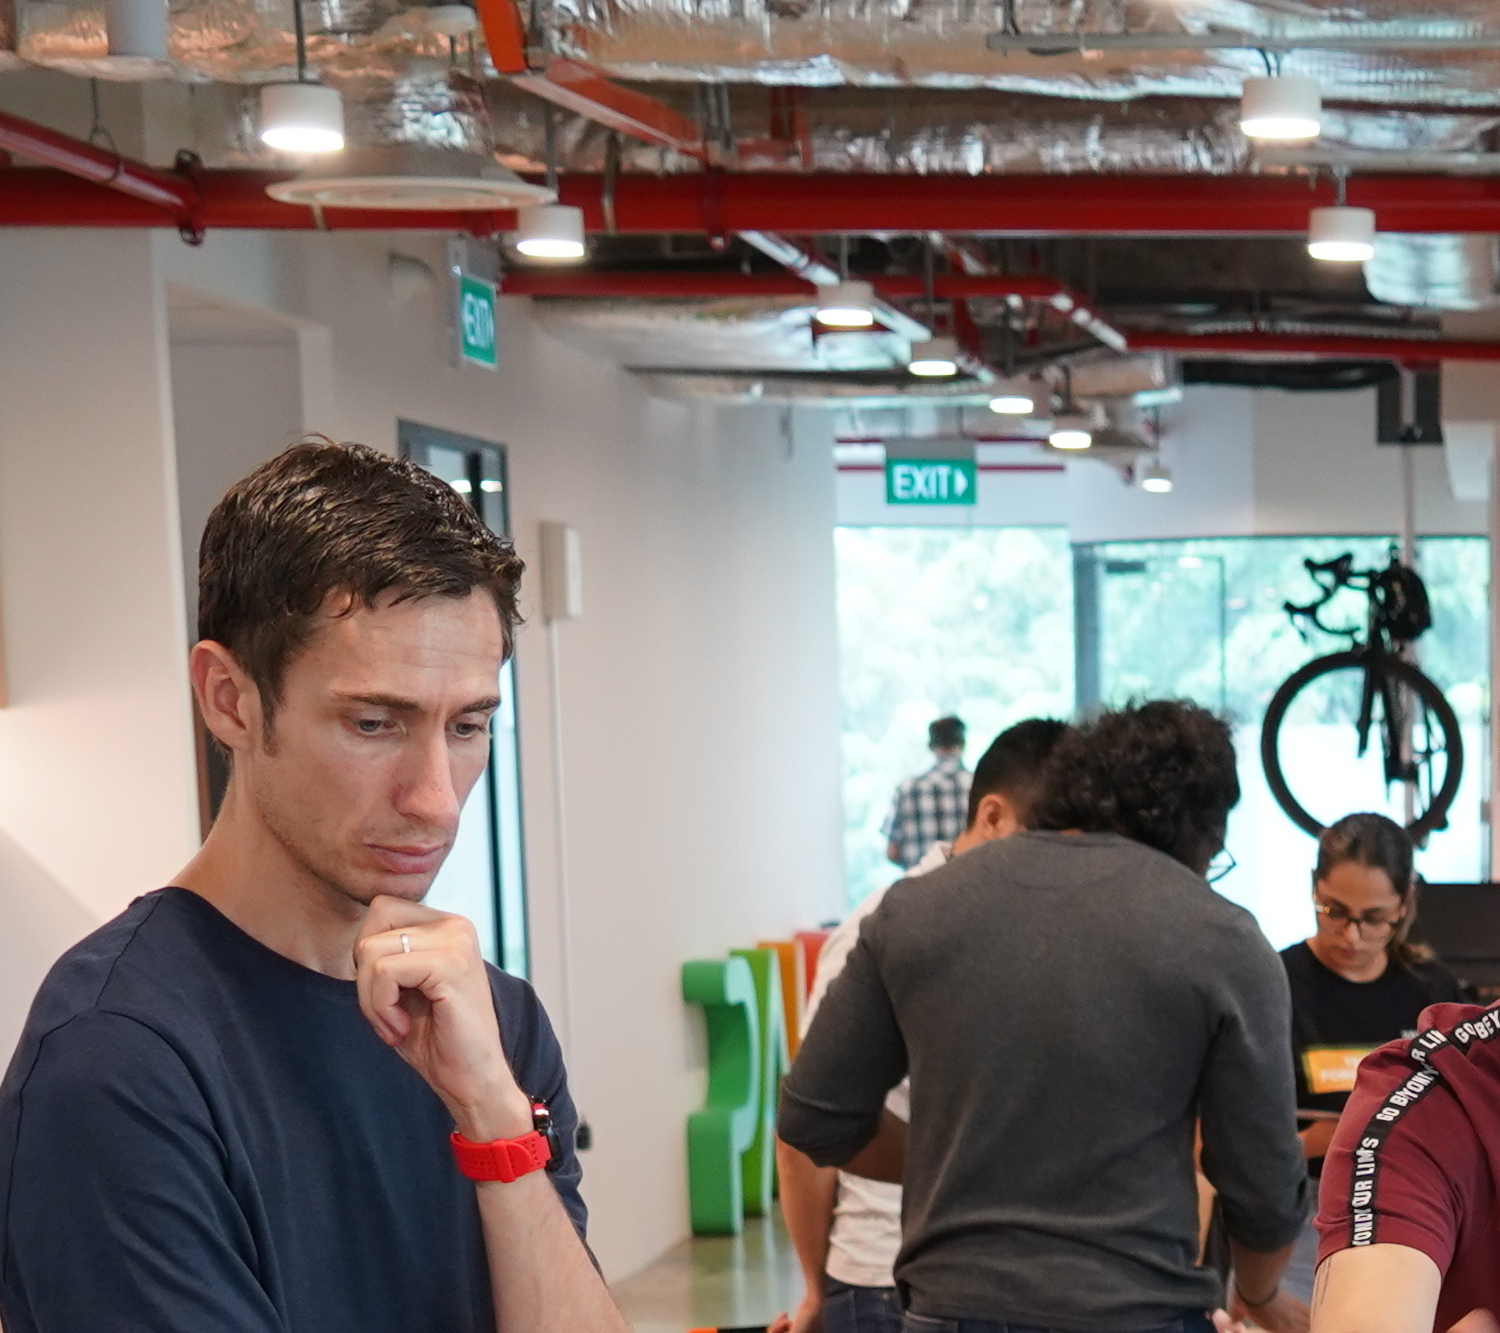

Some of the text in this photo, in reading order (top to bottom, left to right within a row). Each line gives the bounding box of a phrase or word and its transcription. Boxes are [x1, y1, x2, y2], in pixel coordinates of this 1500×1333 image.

[892, 464, 951, 501] EXIT
[1454, 1023, 1475, 1044] GO
[1376, 1107, 1400, 1122] GO
